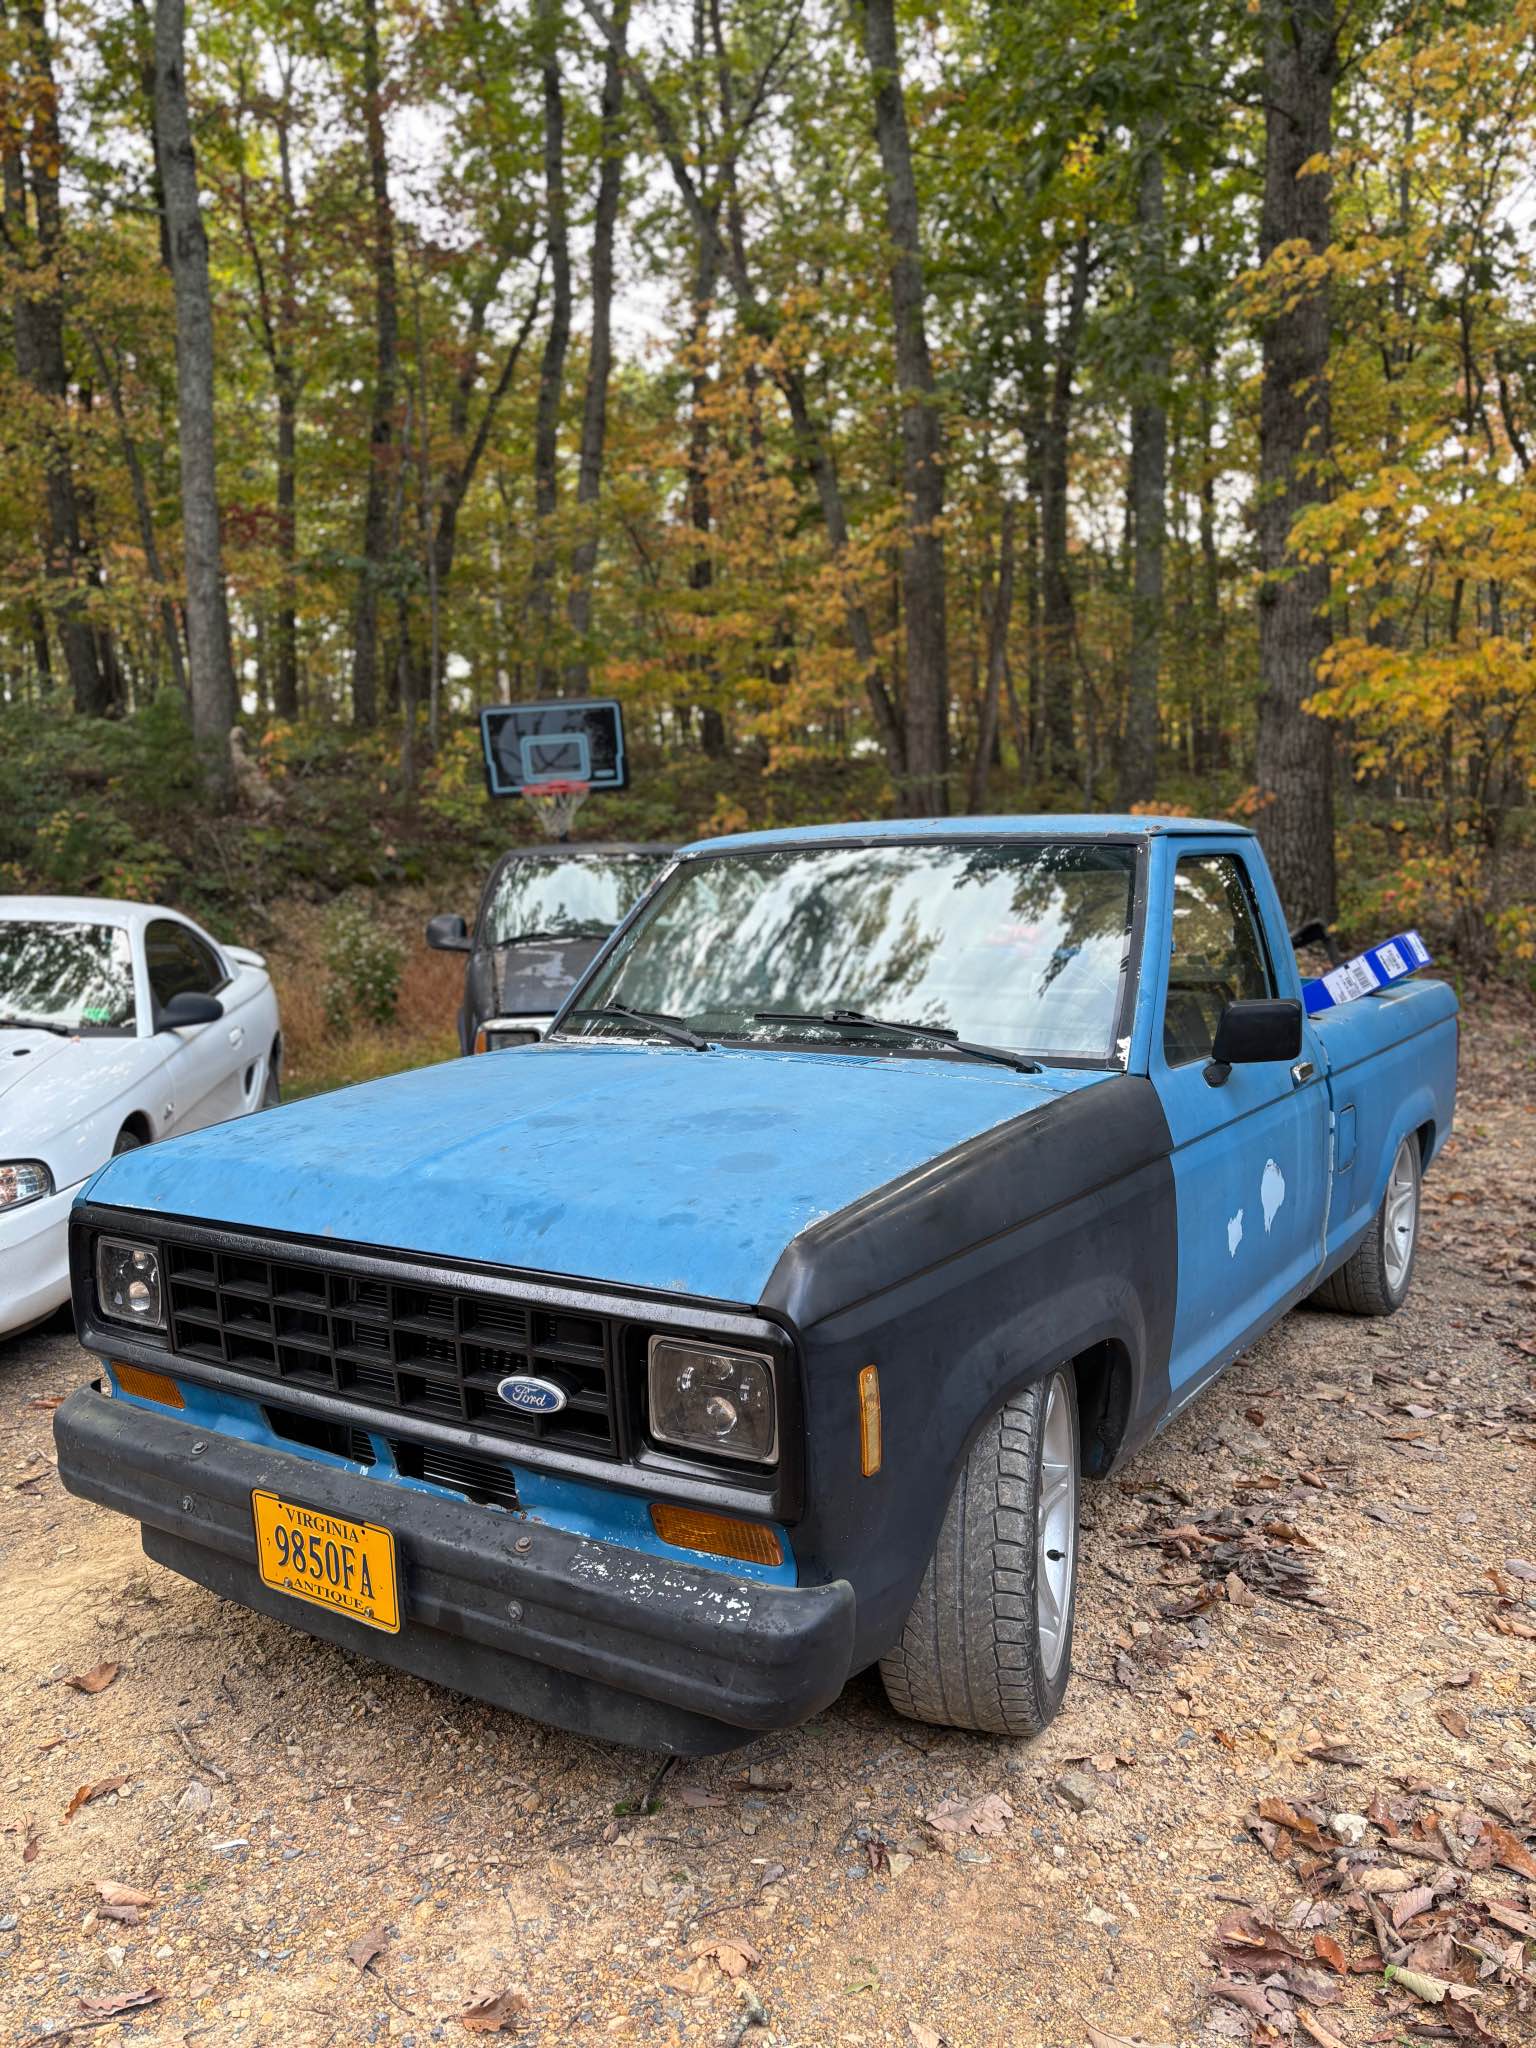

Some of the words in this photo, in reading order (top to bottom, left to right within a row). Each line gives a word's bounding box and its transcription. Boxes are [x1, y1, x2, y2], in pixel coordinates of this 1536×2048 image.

[512, 1385, 546, 1407] Ford
[286, 1508, 360, 1544] VIRGINIA
[274, 1524, 376, 1600] 9850FA
[294, 1578, 364, 1611] ANTIQUE
